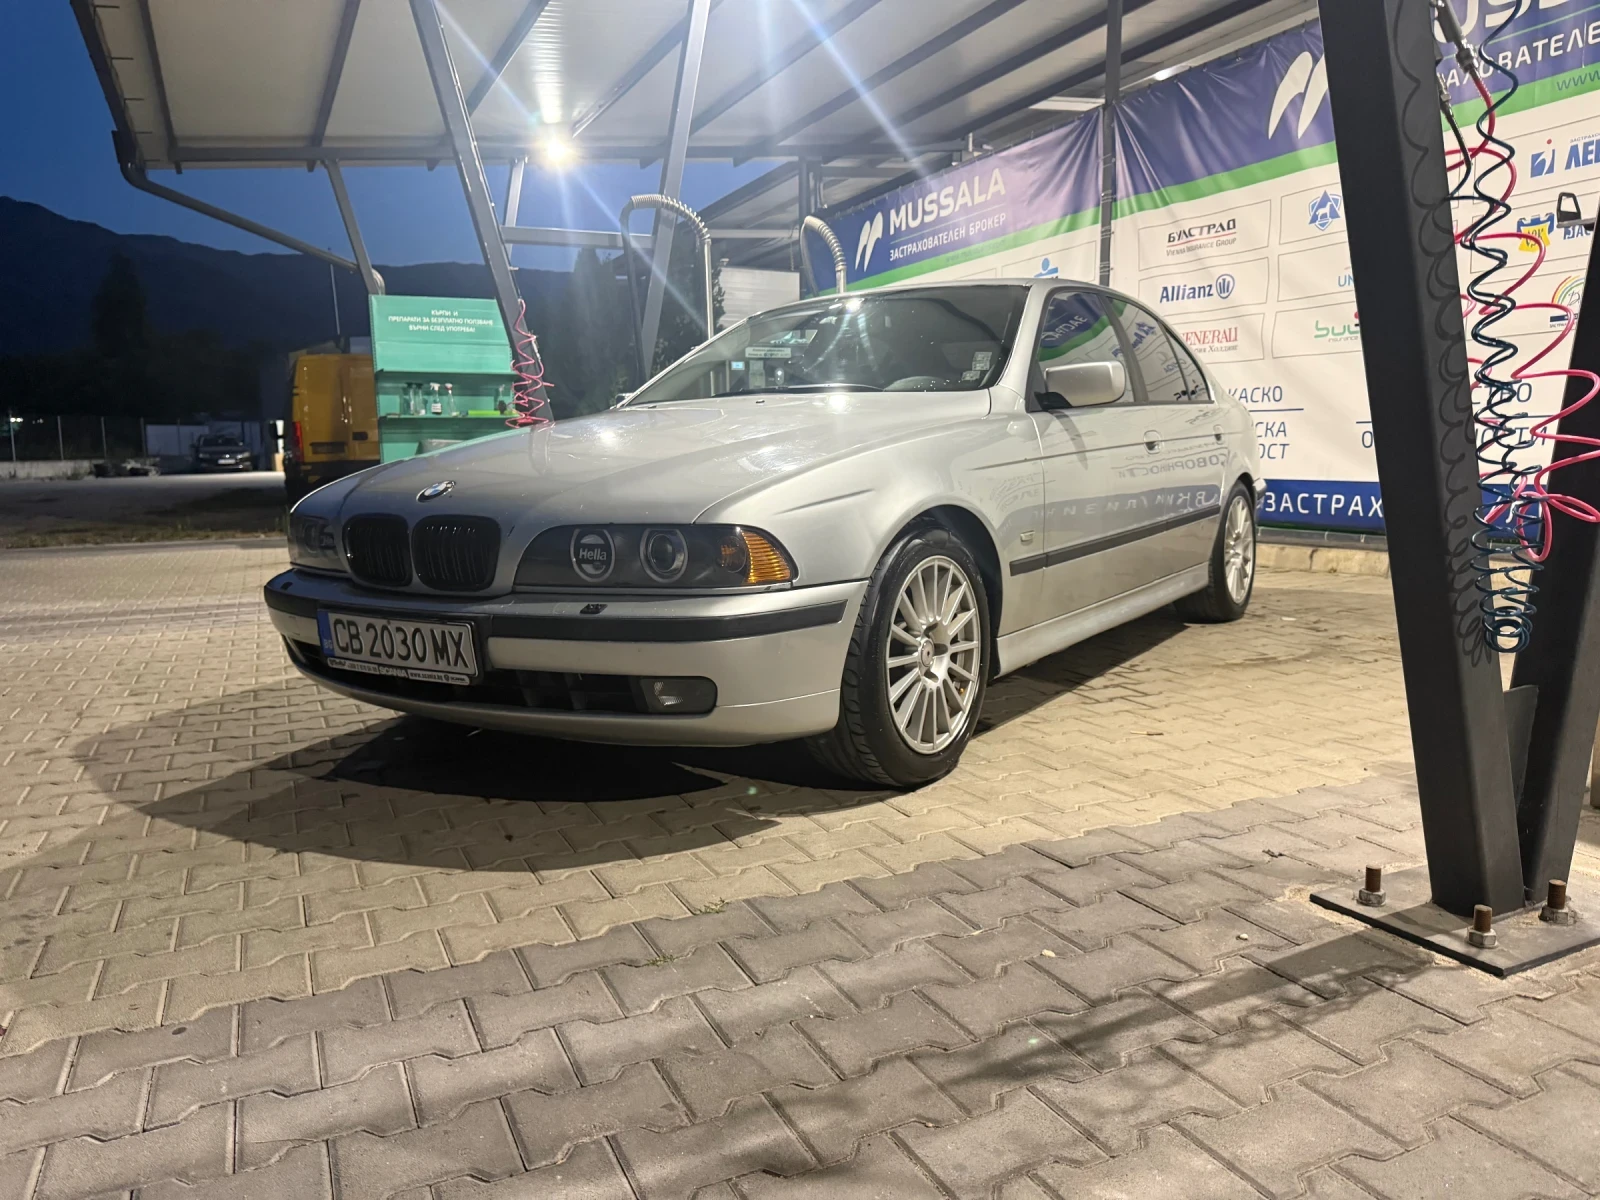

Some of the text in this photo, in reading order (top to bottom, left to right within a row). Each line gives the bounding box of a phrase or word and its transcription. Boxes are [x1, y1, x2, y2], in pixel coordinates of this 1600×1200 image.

[890, 168, 1006, 235] MUSSALA
[889, 227, 966, 261] ЗАСТРАХОВАТЕЛЕН
[969, 213, 1006, 236] БРОКЕР
[1160, 282, 1214, 303] Allianz
[1180, 327, 1238, 345] ENERALI
[579, 548, 607, 560] Hella
